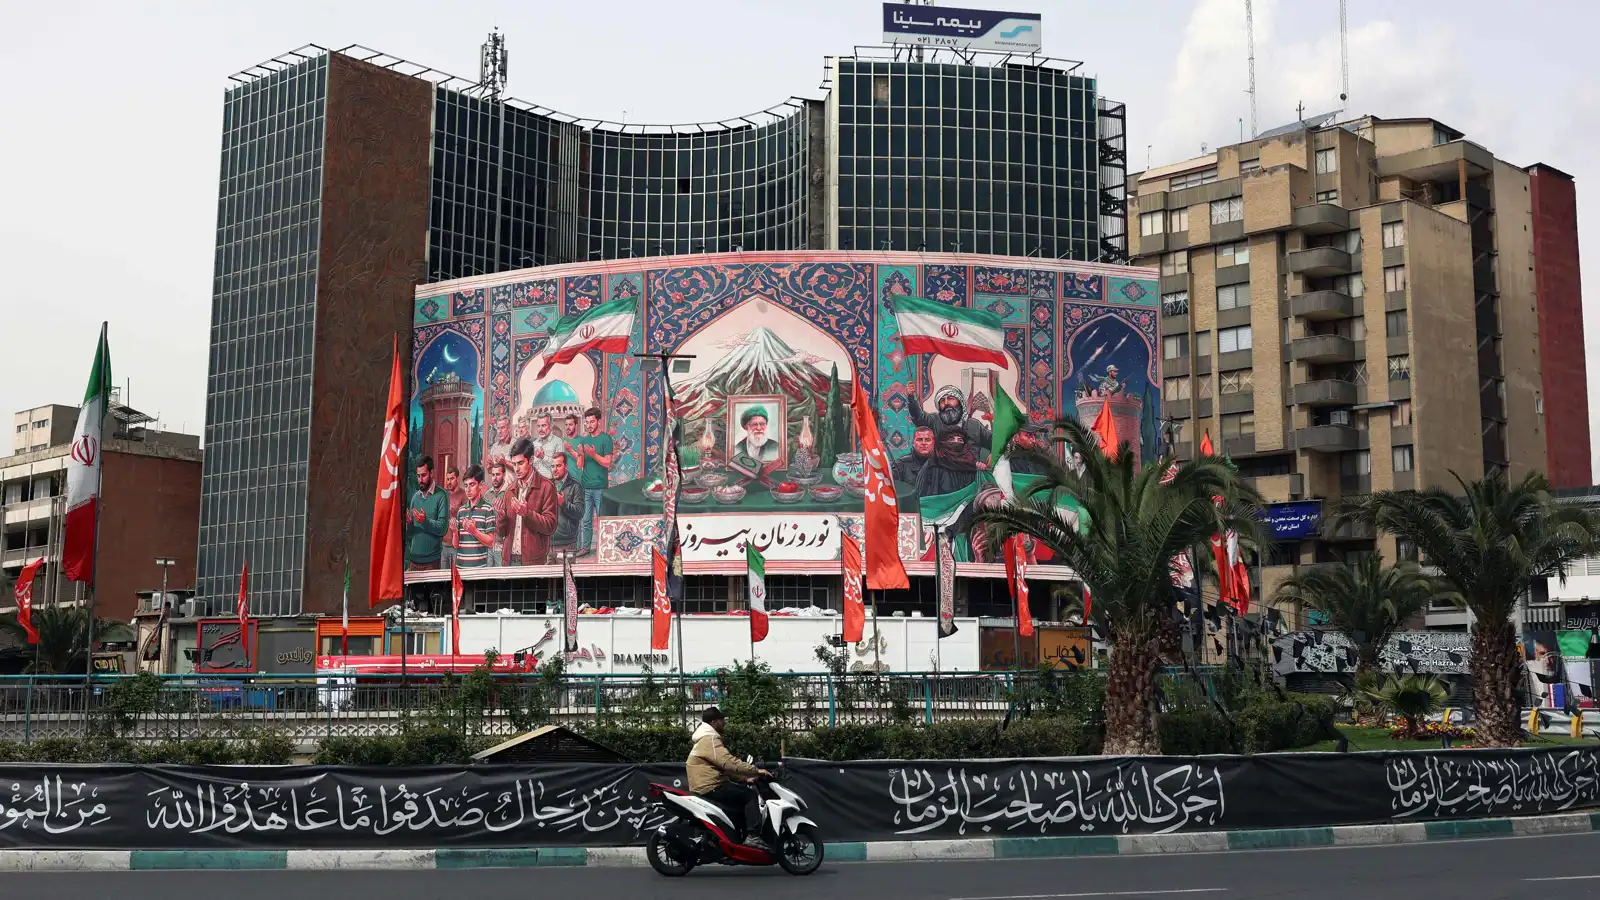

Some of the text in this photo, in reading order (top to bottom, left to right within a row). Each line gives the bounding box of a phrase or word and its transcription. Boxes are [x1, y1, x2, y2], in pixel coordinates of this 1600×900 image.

[893, 10, 982, 34] بیمه سینا
[679, 522, 752, 557] پیروز
